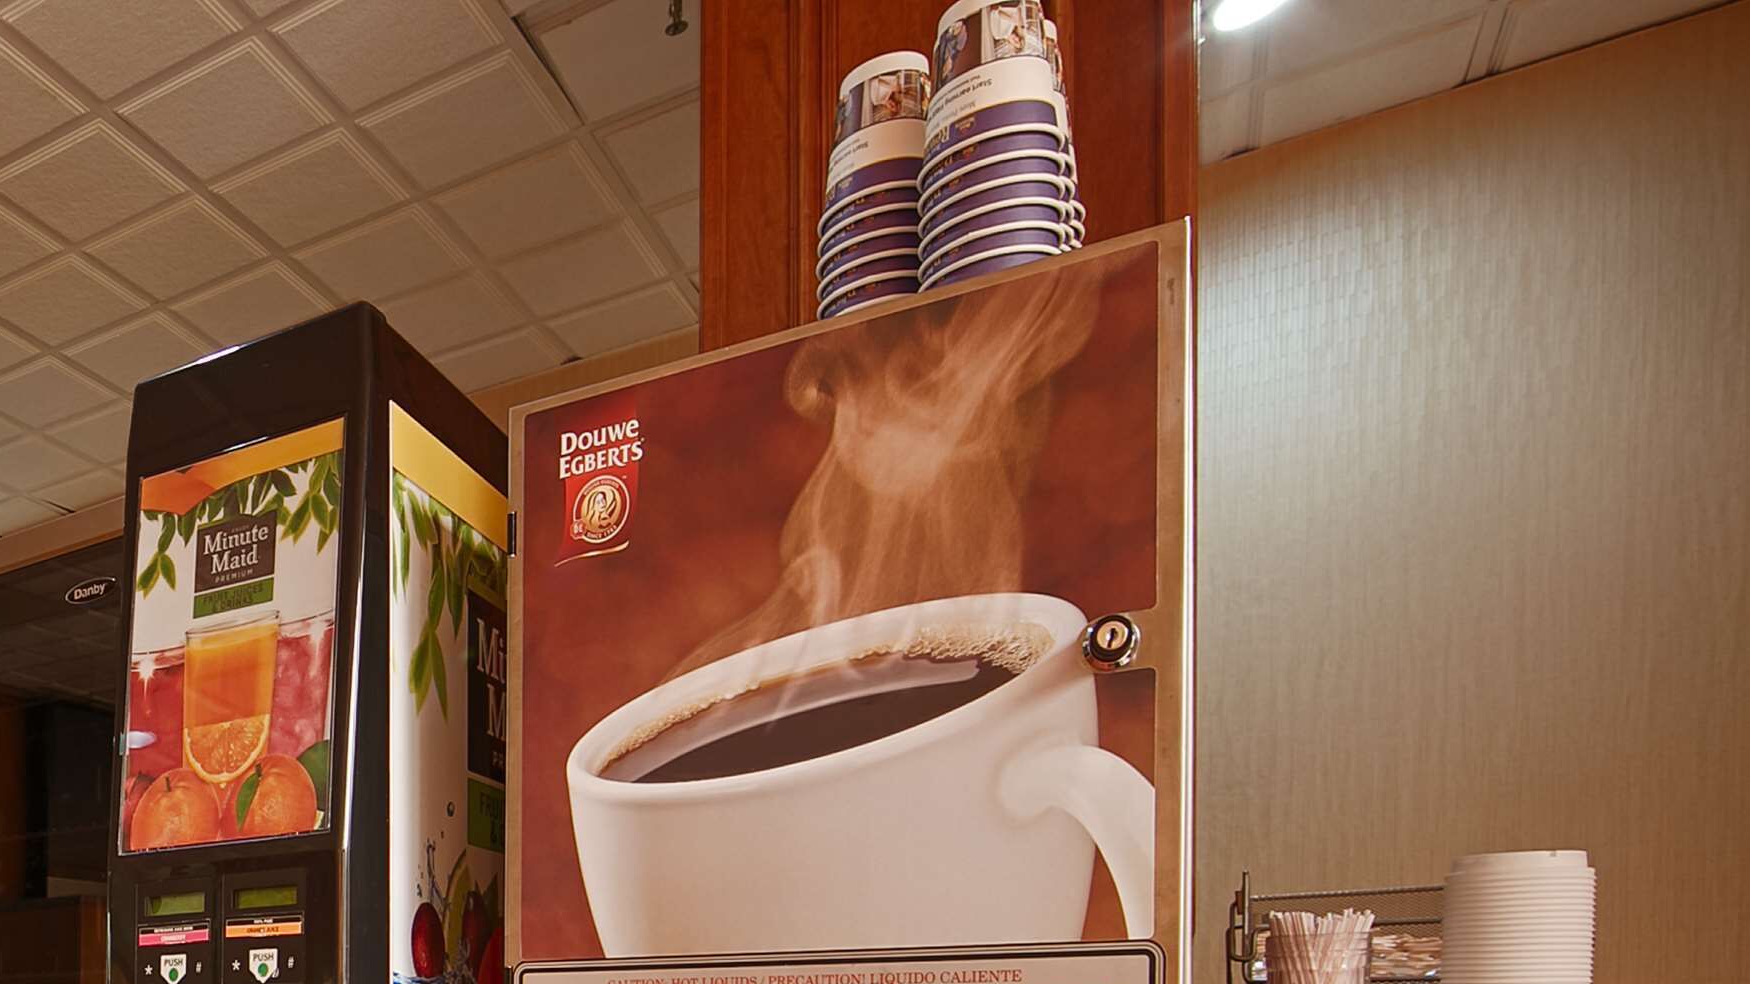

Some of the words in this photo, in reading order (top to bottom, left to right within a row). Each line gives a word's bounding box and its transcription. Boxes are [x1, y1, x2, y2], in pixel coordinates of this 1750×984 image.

[559, 440, 643, 480] EGBERTS
[203, 524, 269, 555] Minute
[211, 544, 258, 574] Maid
[215, 569, 253, 583] PREMIUM
[74, 584, 105, 600] Danby
[164, 958, 183, 967] PUSH
[253, 953, 274, 962] PUSH
[940, 969, 1023, 984] CALIENTE
